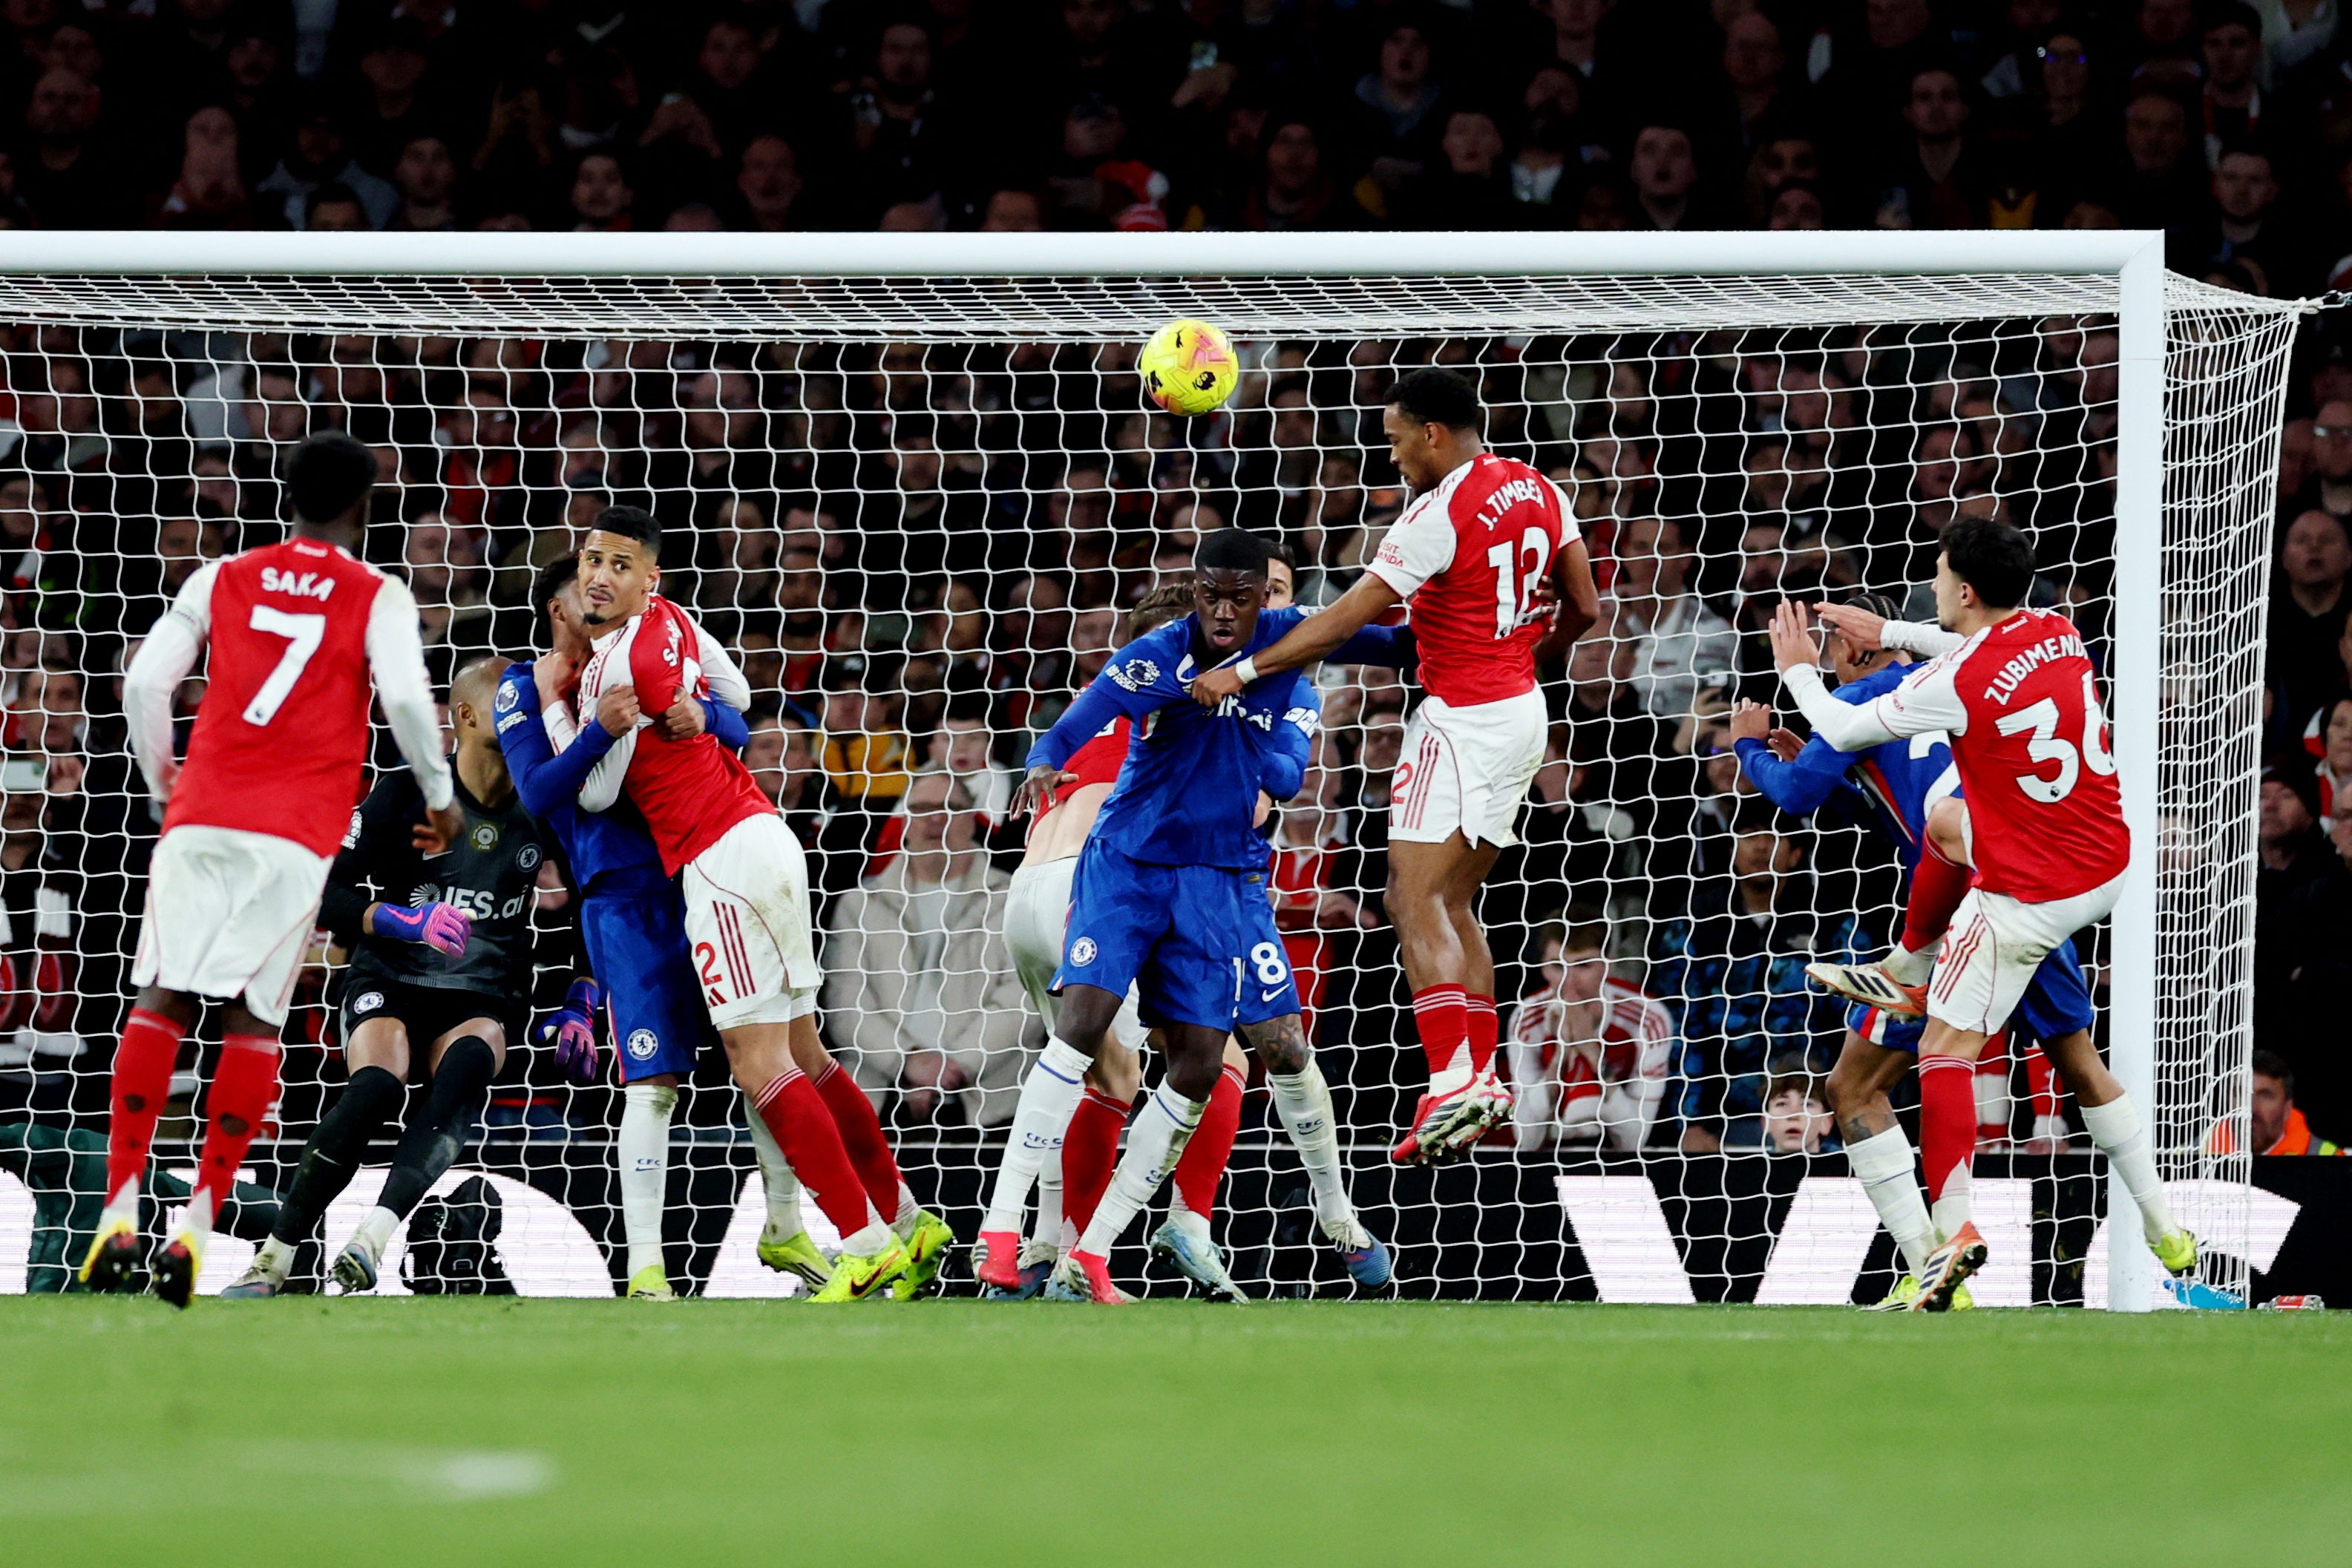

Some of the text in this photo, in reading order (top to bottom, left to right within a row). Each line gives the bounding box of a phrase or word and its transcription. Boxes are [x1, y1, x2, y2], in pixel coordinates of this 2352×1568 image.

[261, 566, 336, 602] SAKA
[1487, 526, 1550, 640] 12
[248, 603, 327, 726] 7
[1391, 762, 1413, 804] 2
[1994, 696, 2117, 804] 36
[695, 942, 722, 986] 2
